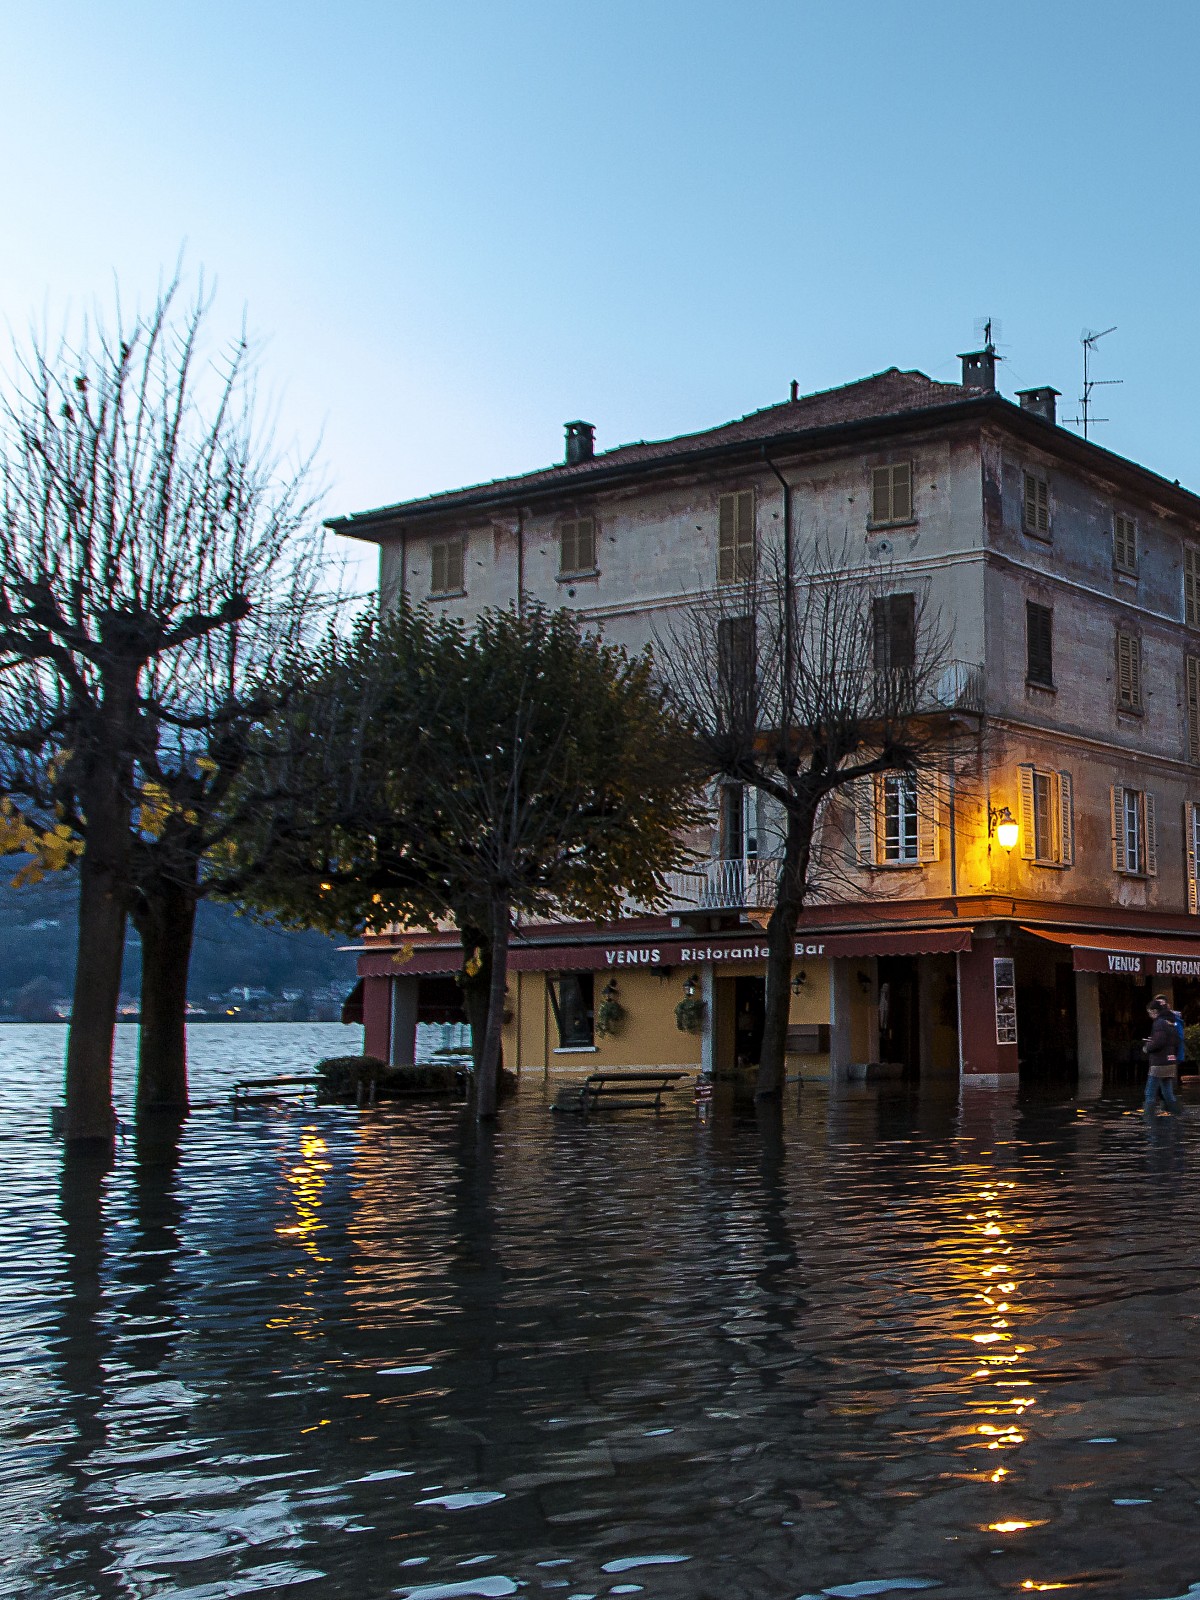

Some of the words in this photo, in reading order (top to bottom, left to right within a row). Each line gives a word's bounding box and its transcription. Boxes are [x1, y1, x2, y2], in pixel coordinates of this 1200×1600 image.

[605, 949, 661, 964] VENUS
[681, 945, 770, 961] Ristorante
[794, 943, 825, 955] Bar
[1107, 955, 1141, 972] VENUS
